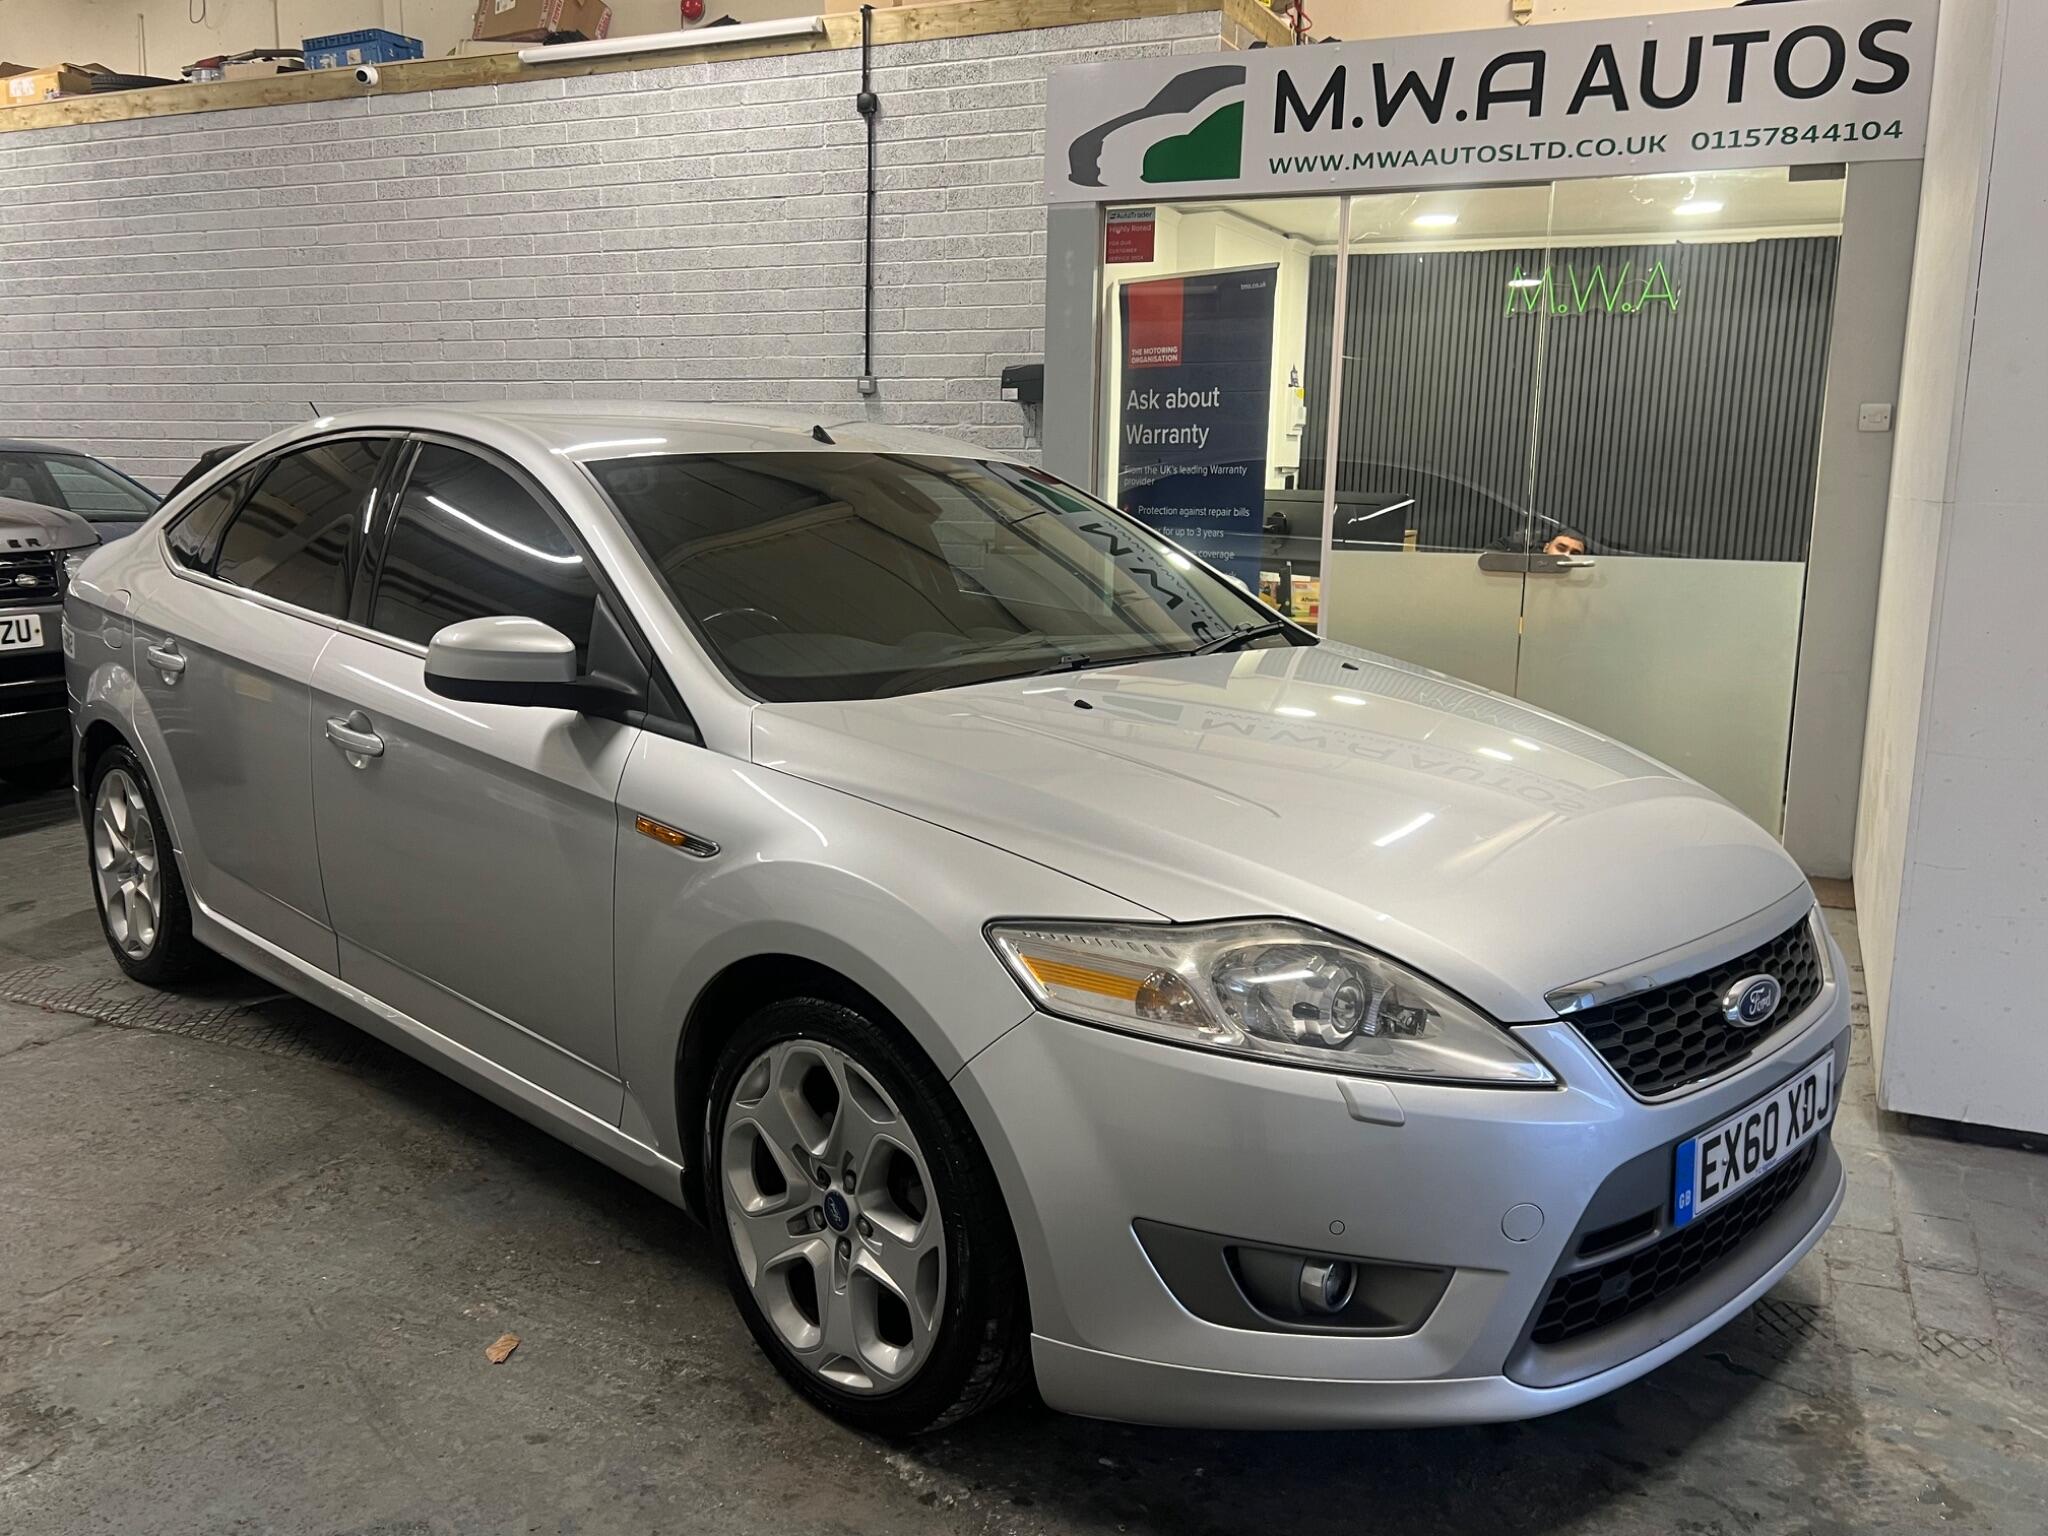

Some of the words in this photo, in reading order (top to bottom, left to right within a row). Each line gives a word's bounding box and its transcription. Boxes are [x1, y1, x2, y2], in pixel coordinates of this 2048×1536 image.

[1273, 50, 1546, 134] M.W.A
[1566, 18, 1913, 115] AUTOS
[1269, 134, 1667, 175] WWW.MWAAUTOSLTD.CO.UK
[1691, 119, 1903, 152] 01157844104
[1131, 348, 1142, 356] THE
[1143, 346, 1178, 355] MOTORING
[1131, 354, 1178, 364] ORGANISATION
[1126, 388, 1160, 411] Ask
[1165, 386, 1220, 409] about
[1126, 423, 1210, 449] Warranty
[1124, 465, 1143, 475] From
[1144, 464, 1158, 475] the
[1160, 465, 1178, 475] UK's
[1179, 464, 1208, 477] leading
[1210, 464, 1248, 477] Warranty
[1124, 476, 1155, 487] provider
[1138, 505, 1178, 516] Protection
[1179, 507, 1207, 518] against
[1208, 507, 1232, 518] repair
[1233, 507, 1250, 517] bills
[1162, 527, 1174, 536] for
[1175, 529, 1185, 539] up
[1186, 528, 1195, 537] to
[1196, 527, 1202, 537] 3
[1203, 529, 1224, 540] years
[1198, 550, 1236, 562] coverage
[1699, 1101, 1779, 1204] EX60
[1786, 1061, 1833, 1147] XDJ
[1678, 1189, 1692, 1210] GB
